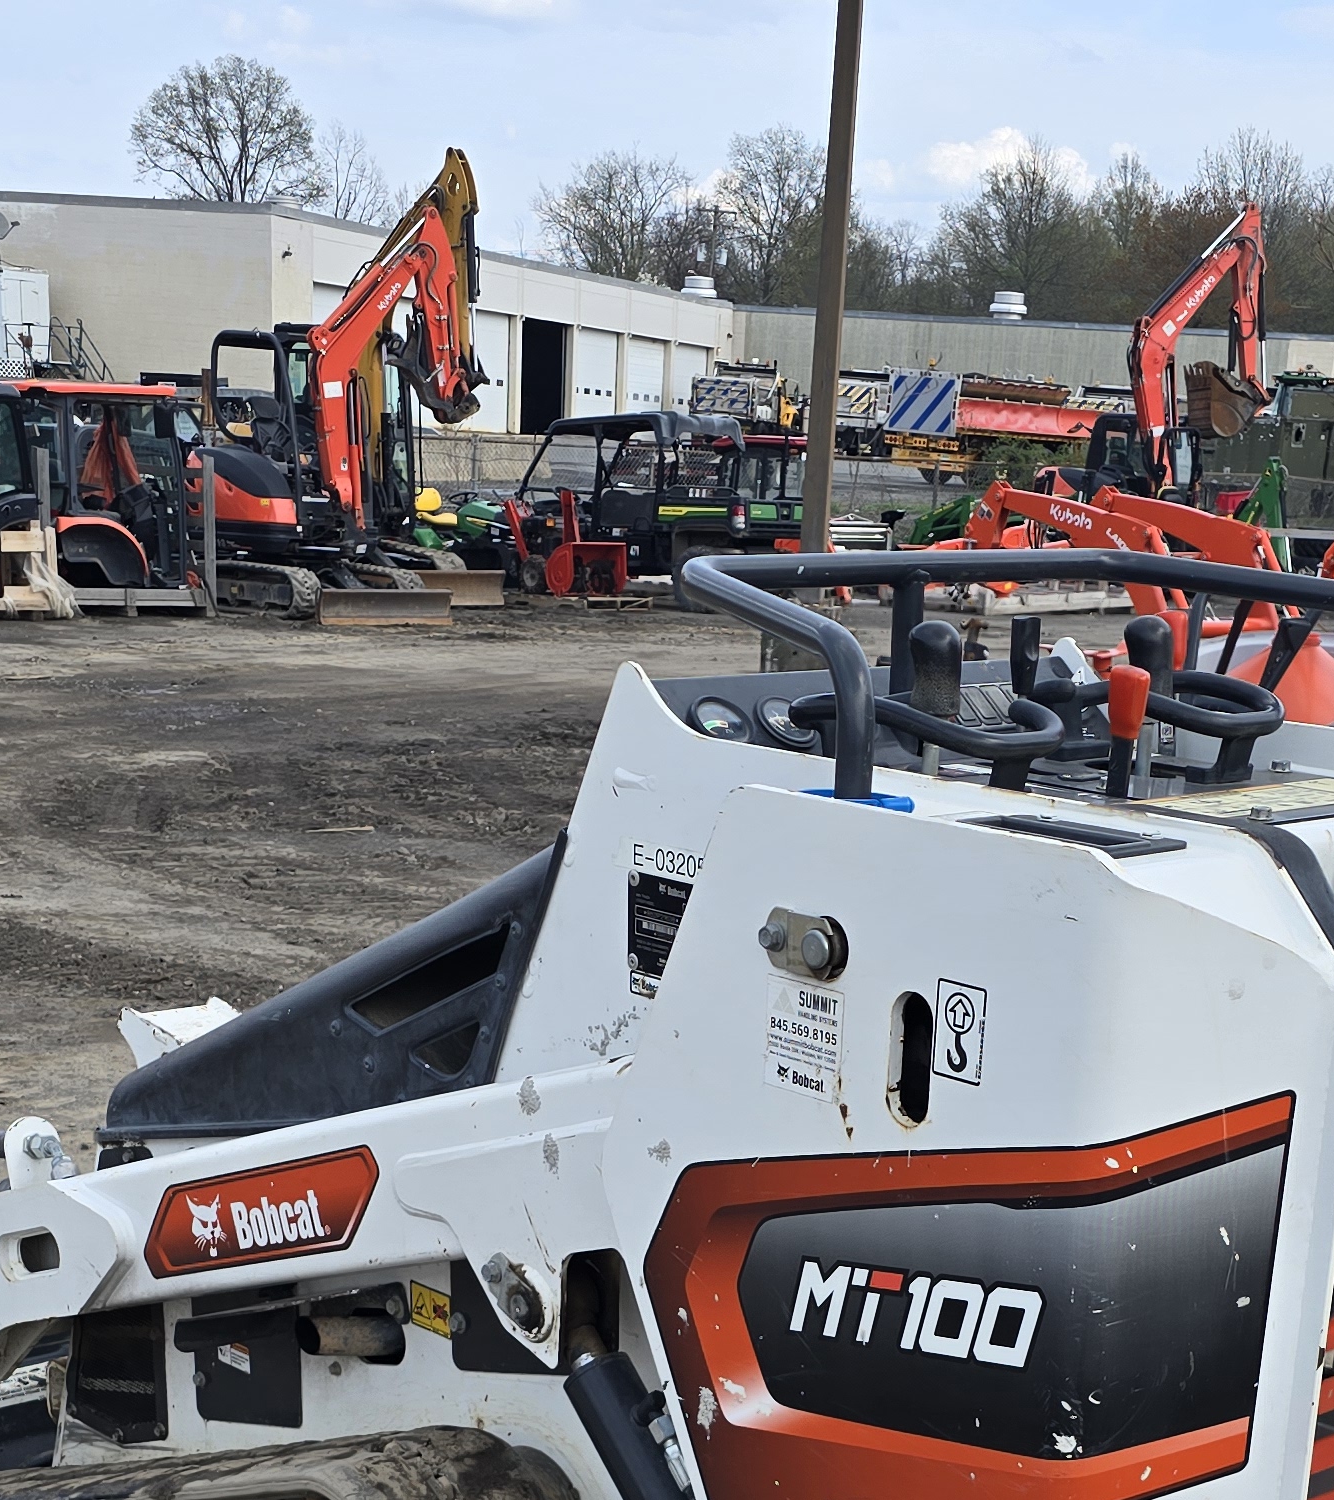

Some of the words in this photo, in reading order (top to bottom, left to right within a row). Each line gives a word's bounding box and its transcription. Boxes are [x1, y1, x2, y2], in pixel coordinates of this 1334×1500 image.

[377, 282, 402, 311] Kubota
[1185, 275, 1216, 309] Kubota
[1049, 503, 1093, 530] Kubota
[798, 990, 838, 1016] SUMMIT
[770, 1016, 838, 1046] 845.569.8195
[792, 1070, 826, 1093] Bobcat
[230, 1189, 325, 1250] Bobcat
